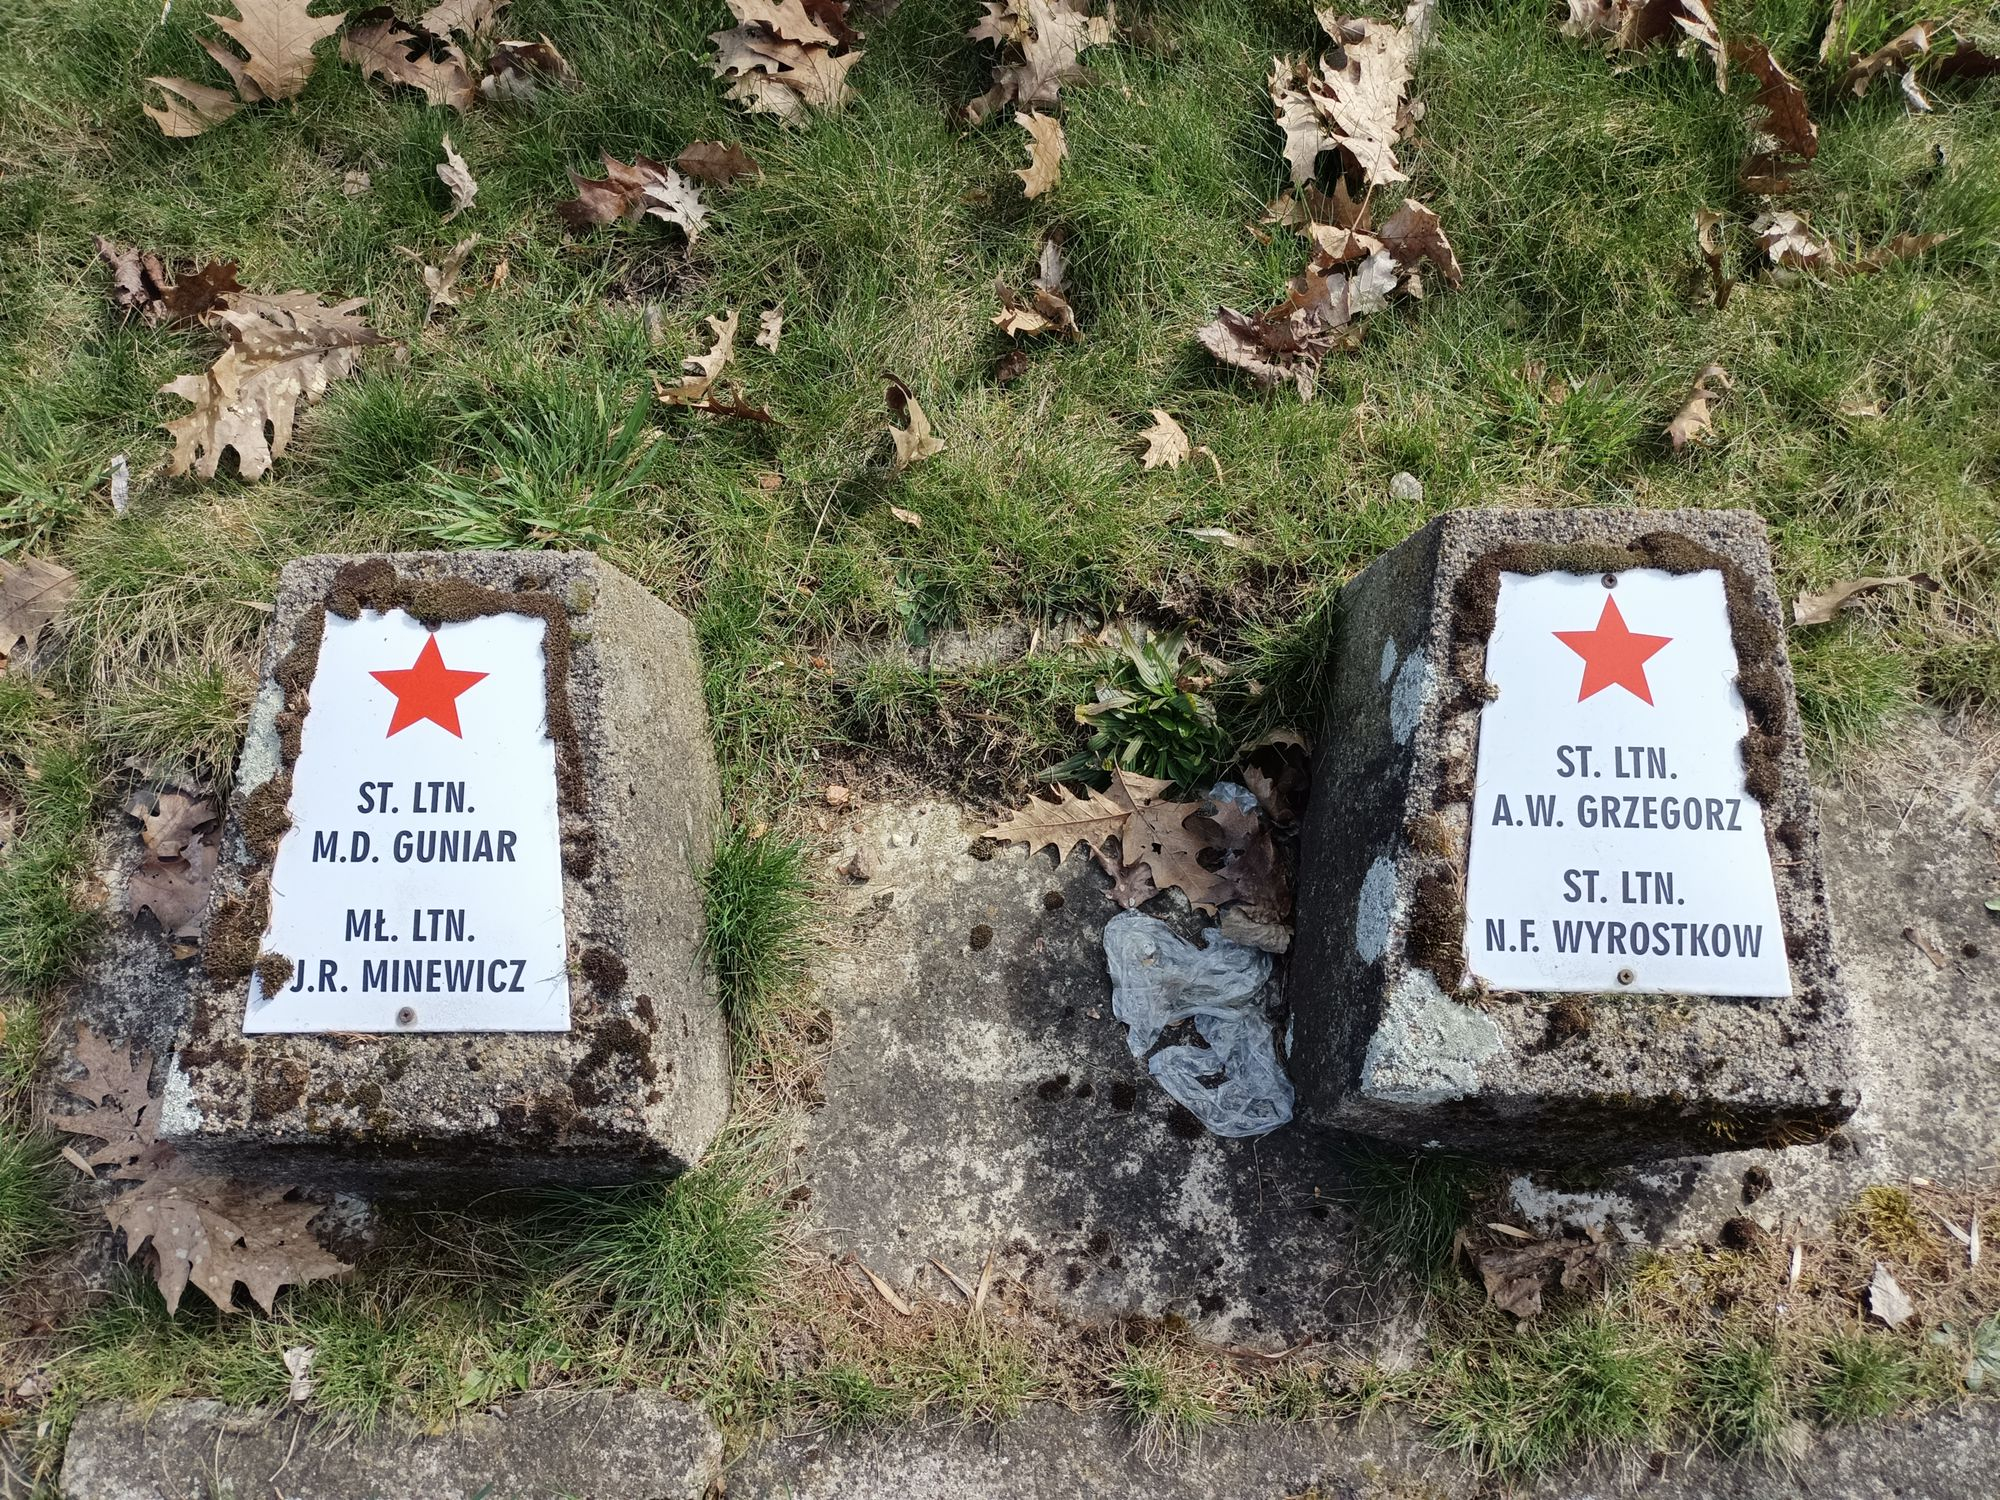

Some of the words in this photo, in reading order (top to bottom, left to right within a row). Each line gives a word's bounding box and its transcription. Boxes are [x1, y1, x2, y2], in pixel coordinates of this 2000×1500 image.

[1556, 745, 1601, 778] ST.
[1614, 746, 1677, 780] LTN.
[357, 781, 399, 814] ST.
[412, 781, 475, 813] LTN.
[1492, 794, 1564, 828] A.W.
[1577, 795, 1741, 832] GRZEGORZ
[312, 830, 379, 864] M.D.
[393, 830, 517, 864] GUNIAR
[1563, 869, 1608, 904] ST.
[1622, 871, 1685, 906] LTN.
[345, 909, 399, 942] MŁ.
[412, 909, 475, 942] LTN.
[1485, 918, 1540, 953] N.F.
[1552, 920, 1763, 959] WYROSTKOW
[289, 959, 348, 993] J.R.
[362, 959, 527, 994] MINEWICZ
